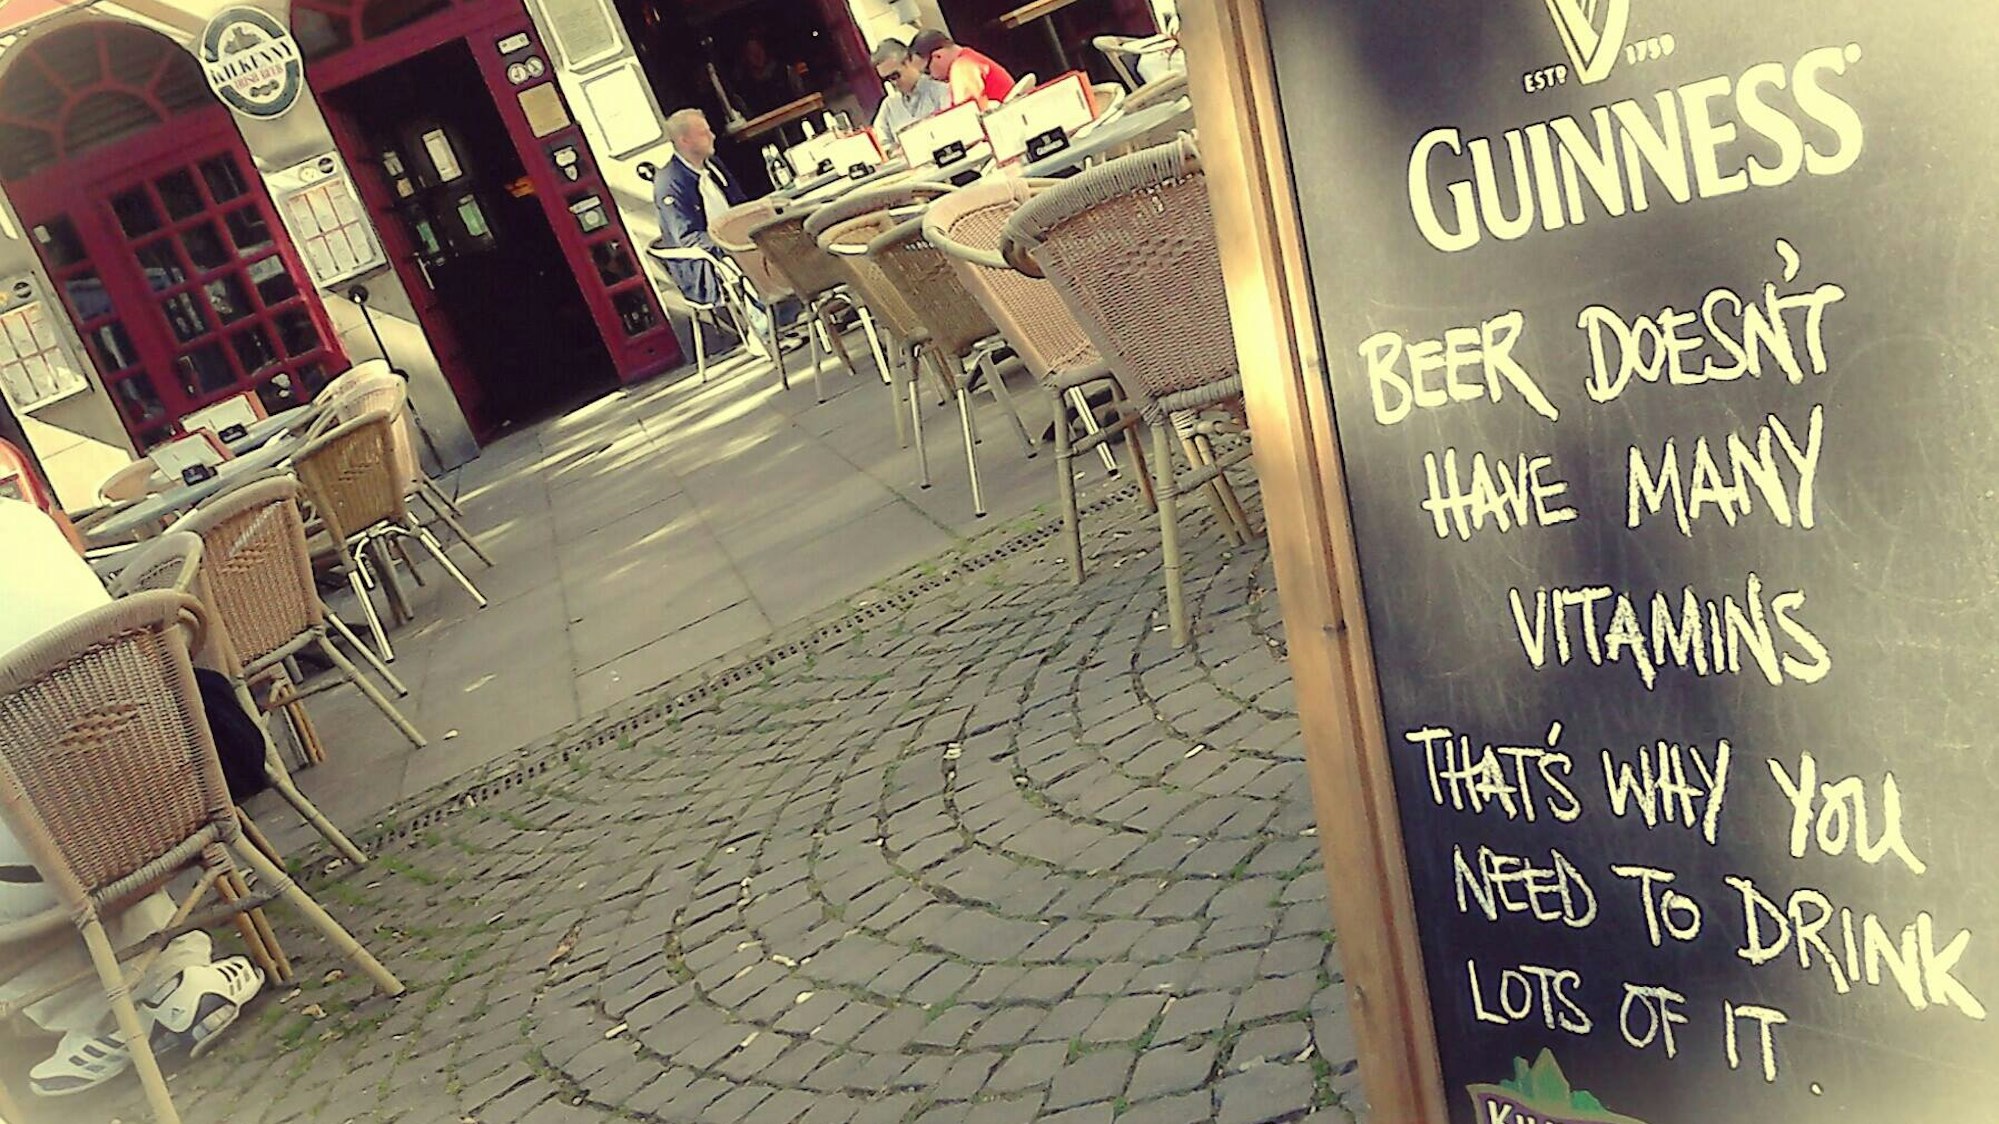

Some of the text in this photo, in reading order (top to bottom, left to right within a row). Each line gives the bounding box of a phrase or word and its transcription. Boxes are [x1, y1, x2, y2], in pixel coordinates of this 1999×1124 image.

[1624, 33, 1675, 65] 1759
[1408, 44, 1864, 253] GUINNESS
[1359, 241, 1844, 424] BEER DOESN'T
[1422, 406, 1822, 540] HAVE MANY
[1511, 574, 1830, 688] VITAMINS
[1407, 723, 1926, 874] THAT'S WHY YOU
[1455, 845, 1986, 1019] NEED TO DRINK
[1469, 961, 1589, 1034] LOTS
[1620, 983, 1688, 1059] OF
